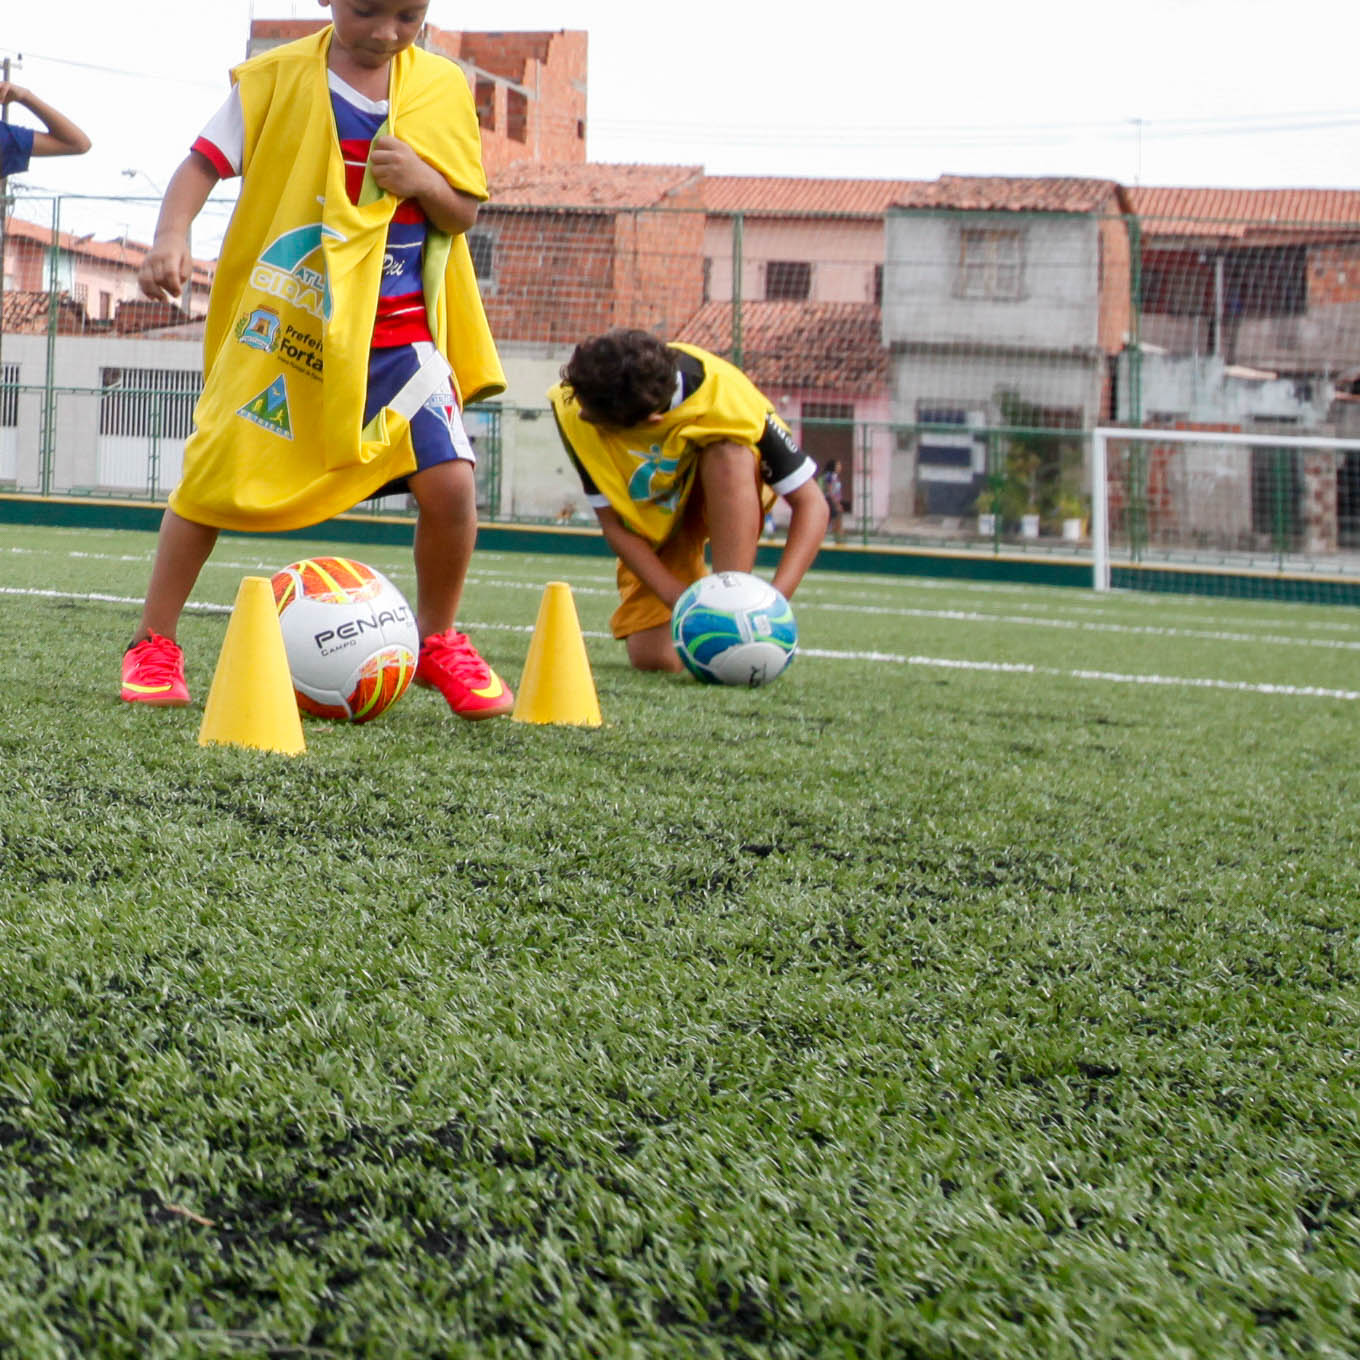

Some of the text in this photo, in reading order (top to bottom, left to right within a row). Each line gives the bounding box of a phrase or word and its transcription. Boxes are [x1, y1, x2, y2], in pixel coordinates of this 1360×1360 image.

[249, 265, 321, 318] CIDA
[295, 267, 323, 290] ATL
[280, 338, 324, 372] Forta
[285, 325, 323, 352] Prefei
[314, 605, 408, 650] PENALT
